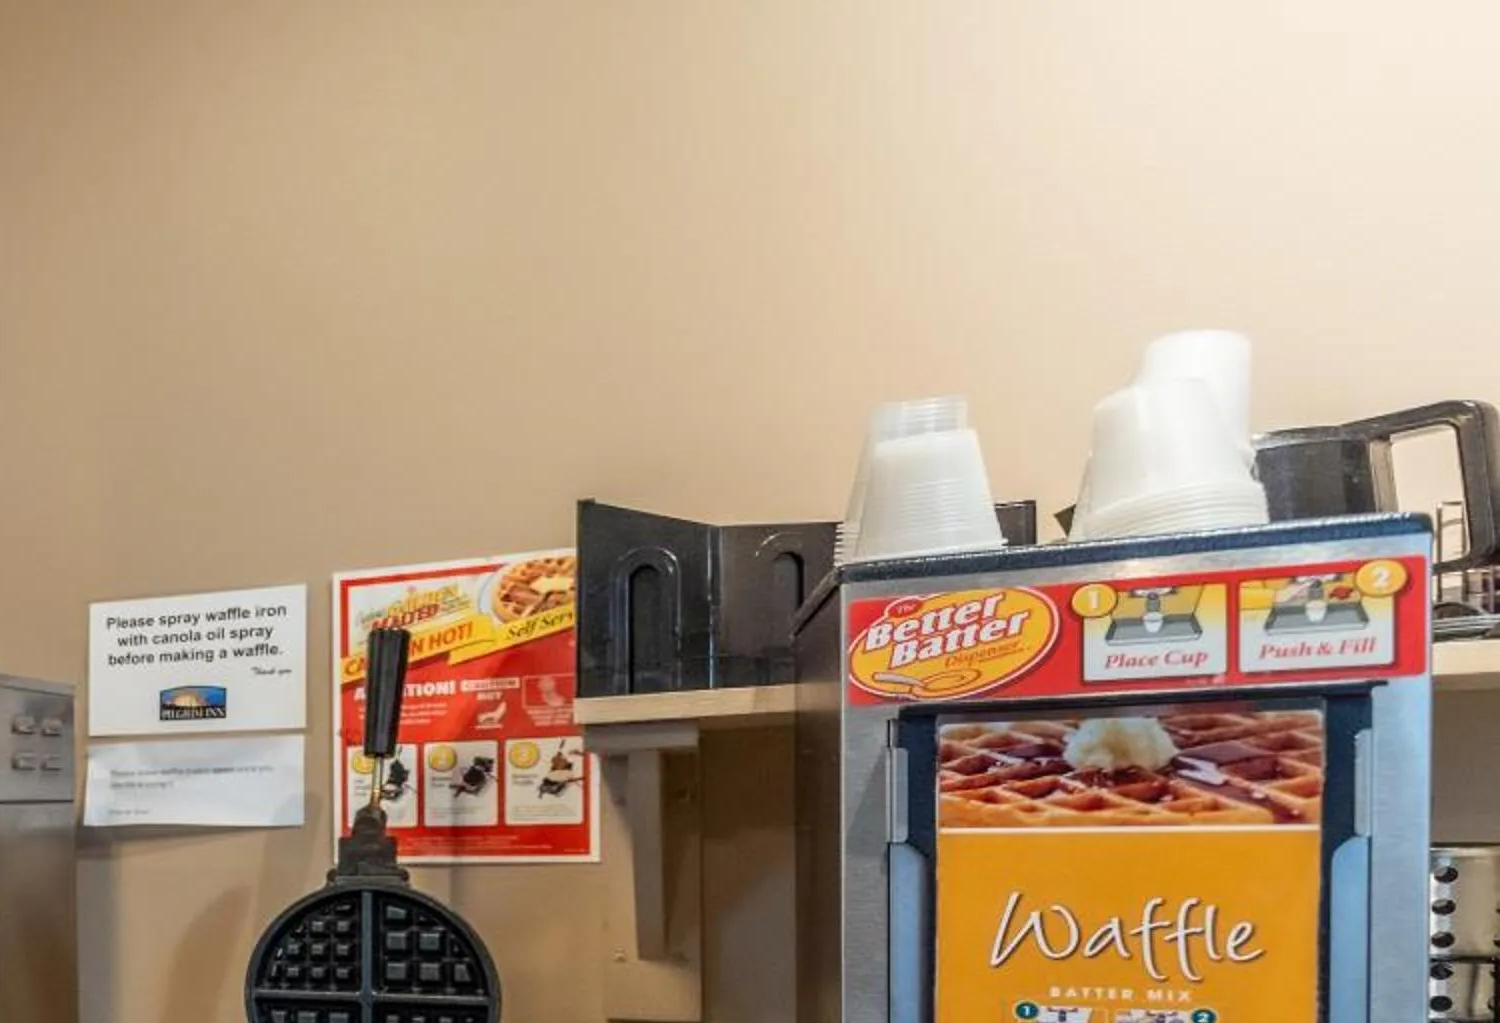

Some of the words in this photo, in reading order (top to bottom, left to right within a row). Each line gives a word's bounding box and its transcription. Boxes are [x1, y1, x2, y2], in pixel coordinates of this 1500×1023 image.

[1373, 569, 1390, 587] 2
[1089, 590, 1099, 609] 1
[106, 616, 155, 630] Please
[159, 613, 200, 628] spray
[206, 607, 250, 622] waffle
[255, 605, 287, 618] iron
[865, 592, 1007, 651] Better
[117, 632, 148, 647] with
[152, 630, 201, 645] canola
[206, 627, 225, 641] oil
[229, 626, 273, 642] spray
[508, 618, 538, 641] Self
[891, 610, 1031, 669] Batter
[108, 652, 155, 666] before
[159, 647, 214, 663] making
[219, 648, 227, 659] a
[233, 643, 284, 658] waffle.
[1105, 653, 1158, 669] Place
[1164, 650, 1208, 669] Cup
[1258, 641, 1313, 660] Push
[1317, 642, 1332, 655] &
[1338, 637, 1376, 655] Fill
[989, 890, 1266, 983] Waffle
[1050, 986, 1134, 1001] BATTER
[1147, 989, 1193, 1003] MIX
[1022, 1004, 1031, 1016] 1
[1197, 1013, 1209, 1023] 2
